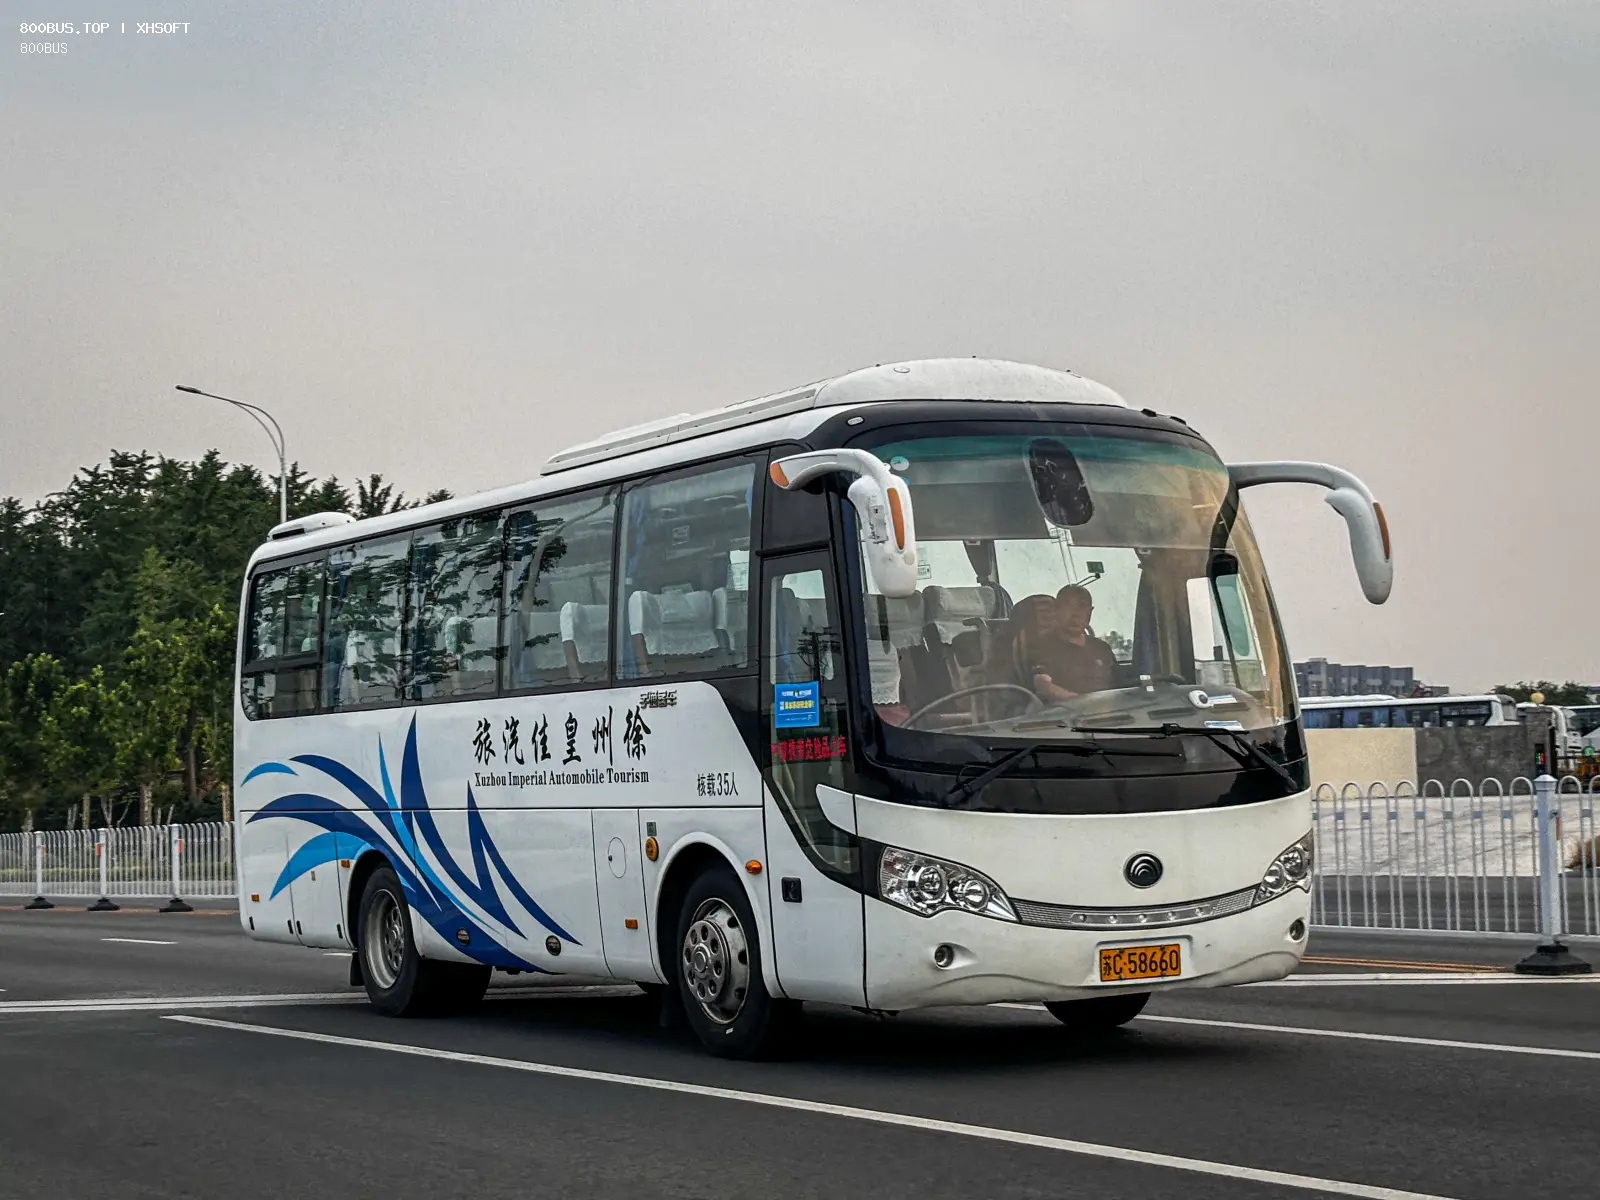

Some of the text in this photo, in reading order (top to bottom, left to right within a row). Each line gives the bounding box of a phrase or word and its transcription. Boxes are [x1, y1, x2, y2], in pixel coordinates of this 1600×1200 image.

[474, 768, 650, 789] Xuzhou Imperial Automobile Tourism
[697, 772, 739, 796] 核载35人
